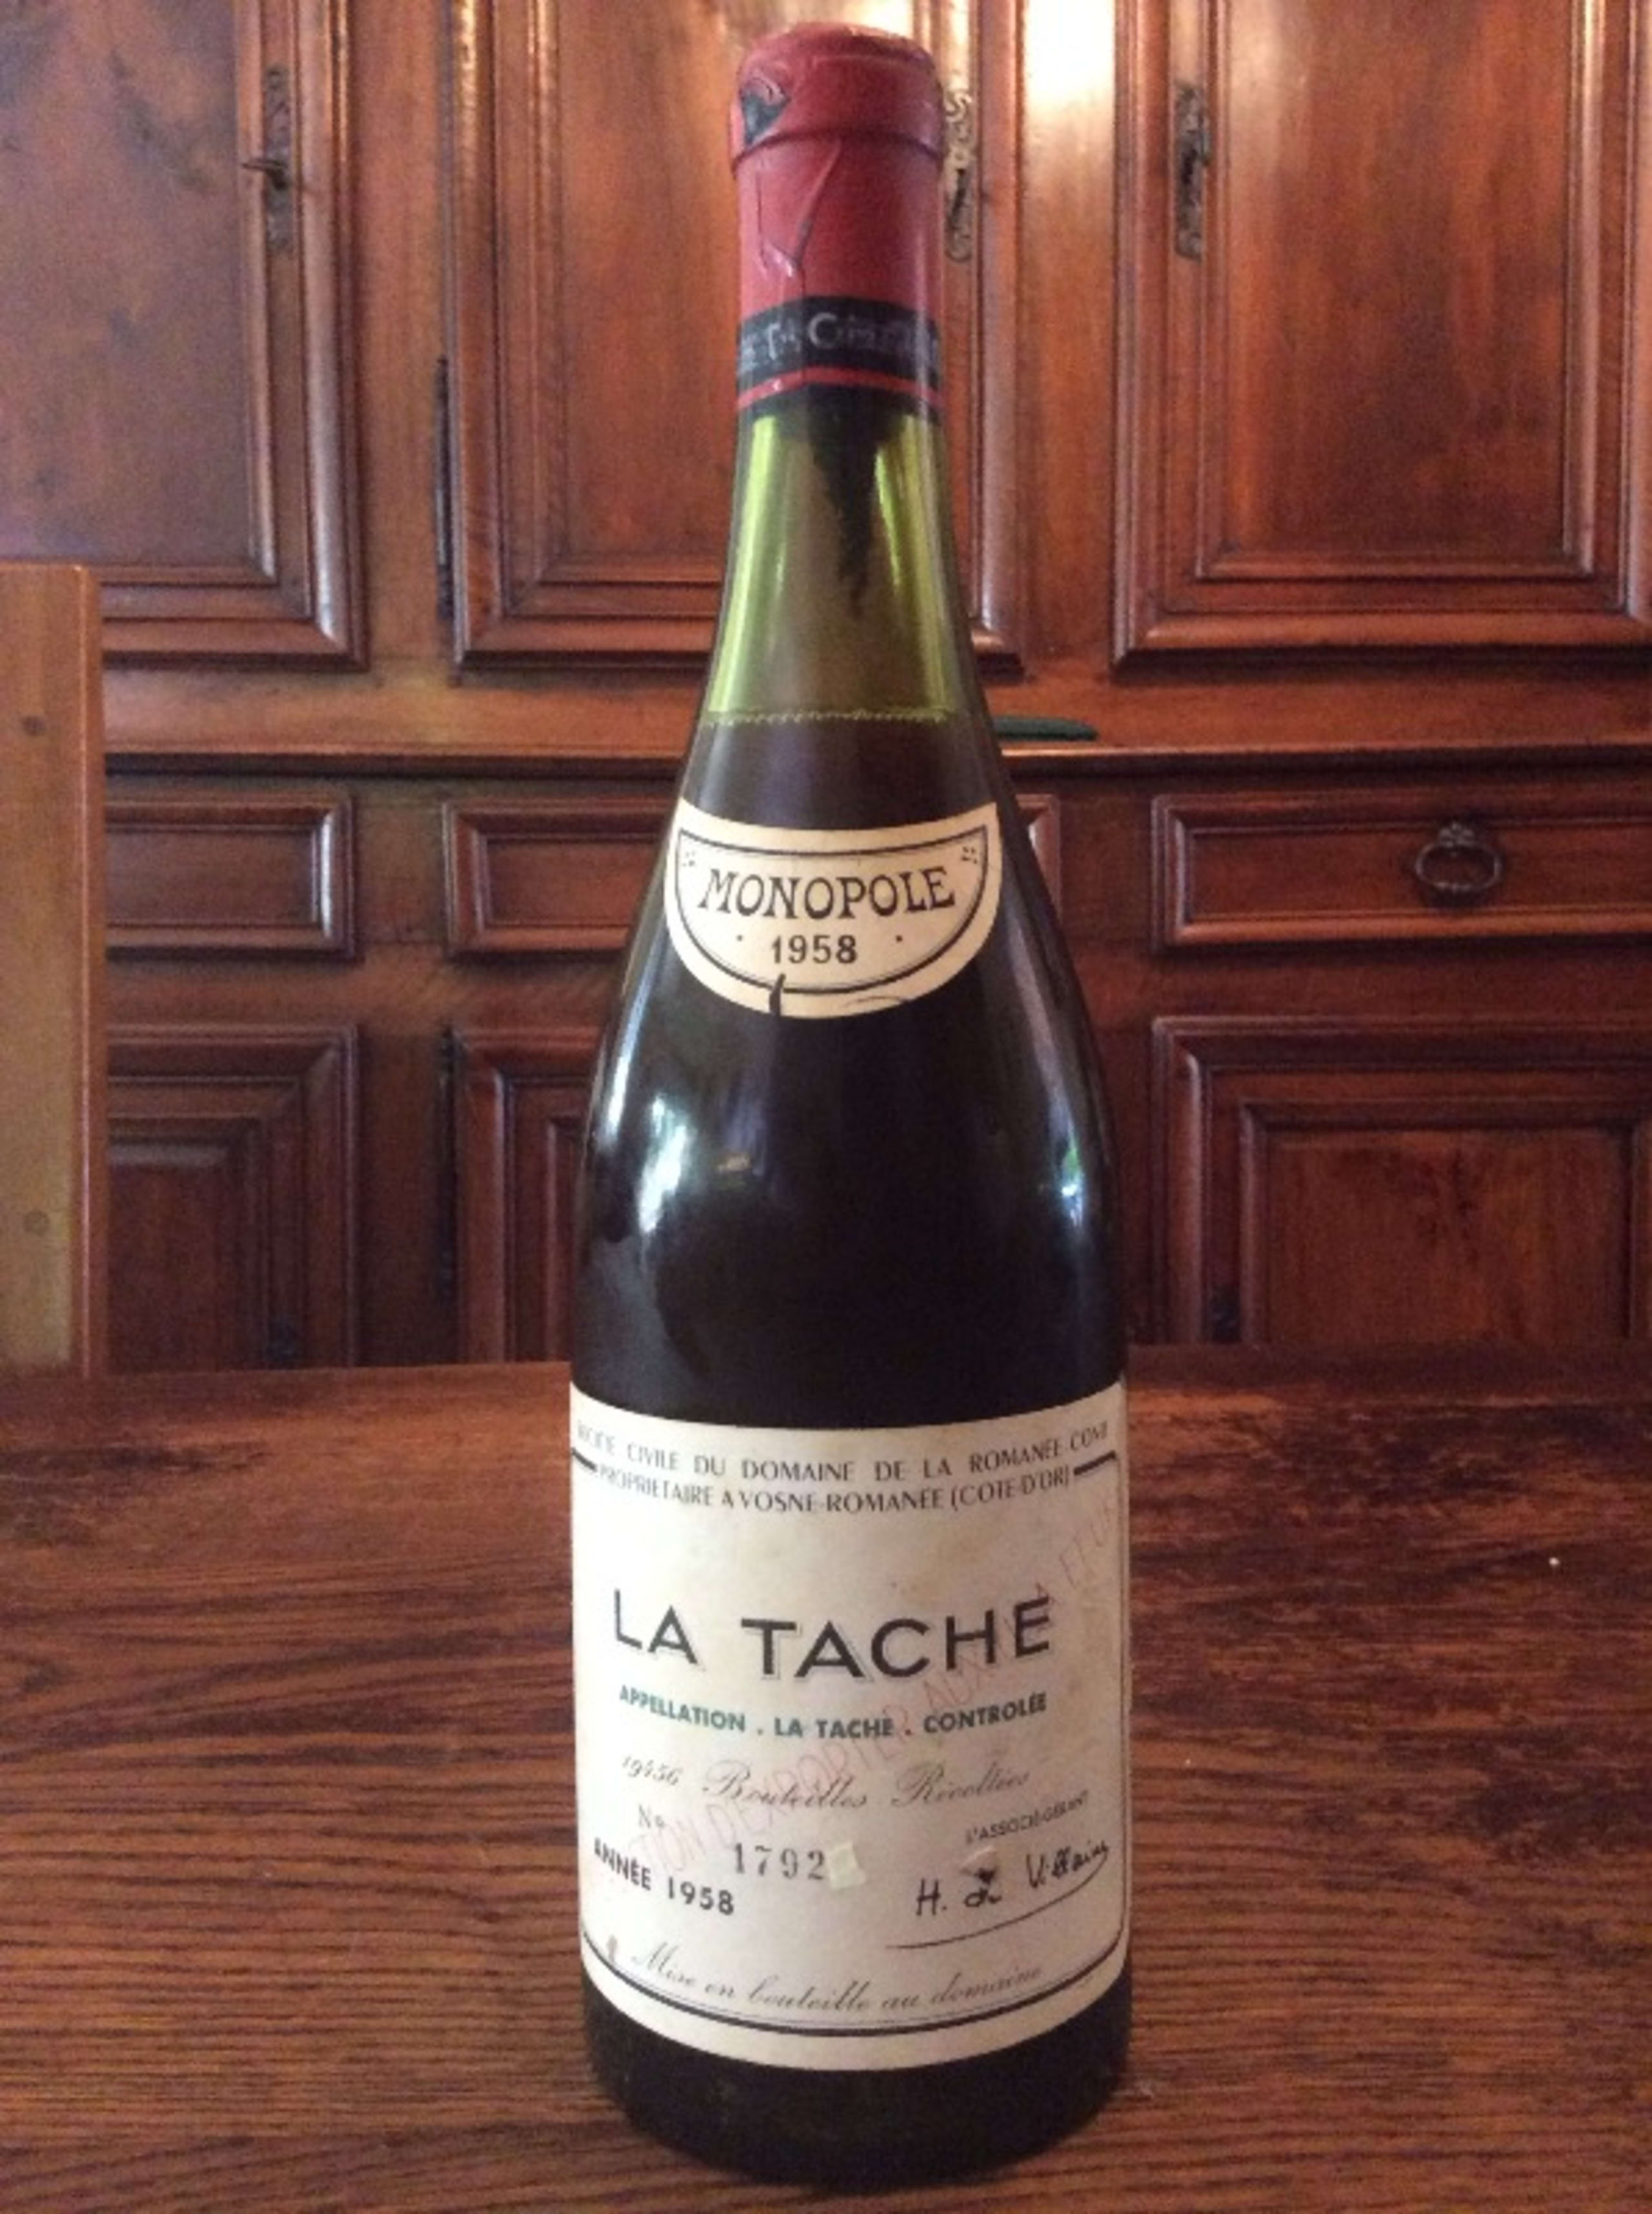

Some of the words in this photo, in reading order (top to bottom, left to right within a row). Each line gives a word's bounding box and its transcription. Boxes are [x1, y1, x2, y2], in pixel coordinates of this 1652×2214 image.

[698, 866, 956, 920] MONOPOLE
[772, 934, 858, 964] 1958
[628, 1441, 679, 1470] CIVILE
[694, 1455, 726, 1476] DU
[741, 1459, 855, 1482] DOMAINE
[874, 1461, 906, 1482] DE
[923, 1458, 952, 1479] LA
[614, 1589, 697, 1665] LA
[741, 1596, 1051, 1678] TACHE
[620, 1685, 746, 1732] APPELLATION
[775, 1718, 804, 1738] LA
[816, 1718, 894, 1739] TACHE
[594, 1837, 652, 1891] ANNÉE
[667, 1876, 735, 1916] 1958
[734, 1842, 826, 1881] 1792
[705, 1984, 736, 1998] en
